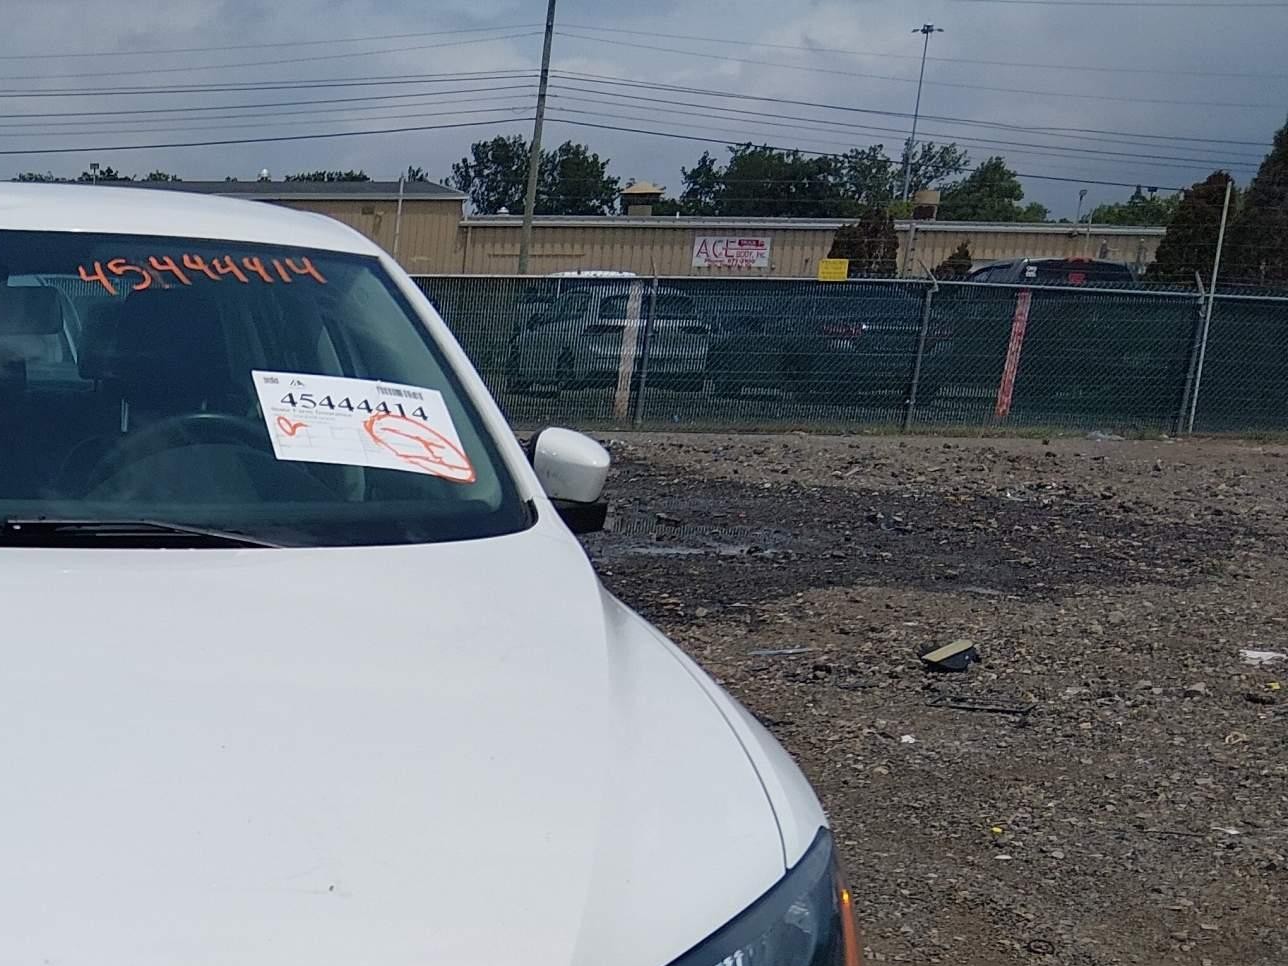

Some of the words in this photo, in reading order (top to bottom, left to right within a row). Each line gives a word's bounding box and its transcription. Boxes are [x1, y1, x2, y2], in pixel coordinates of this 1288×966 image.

[695, 238, 737, 259] ACE
[78, 254, 328, 294] 45444414
[280, 392, 429, 421] 45444414
